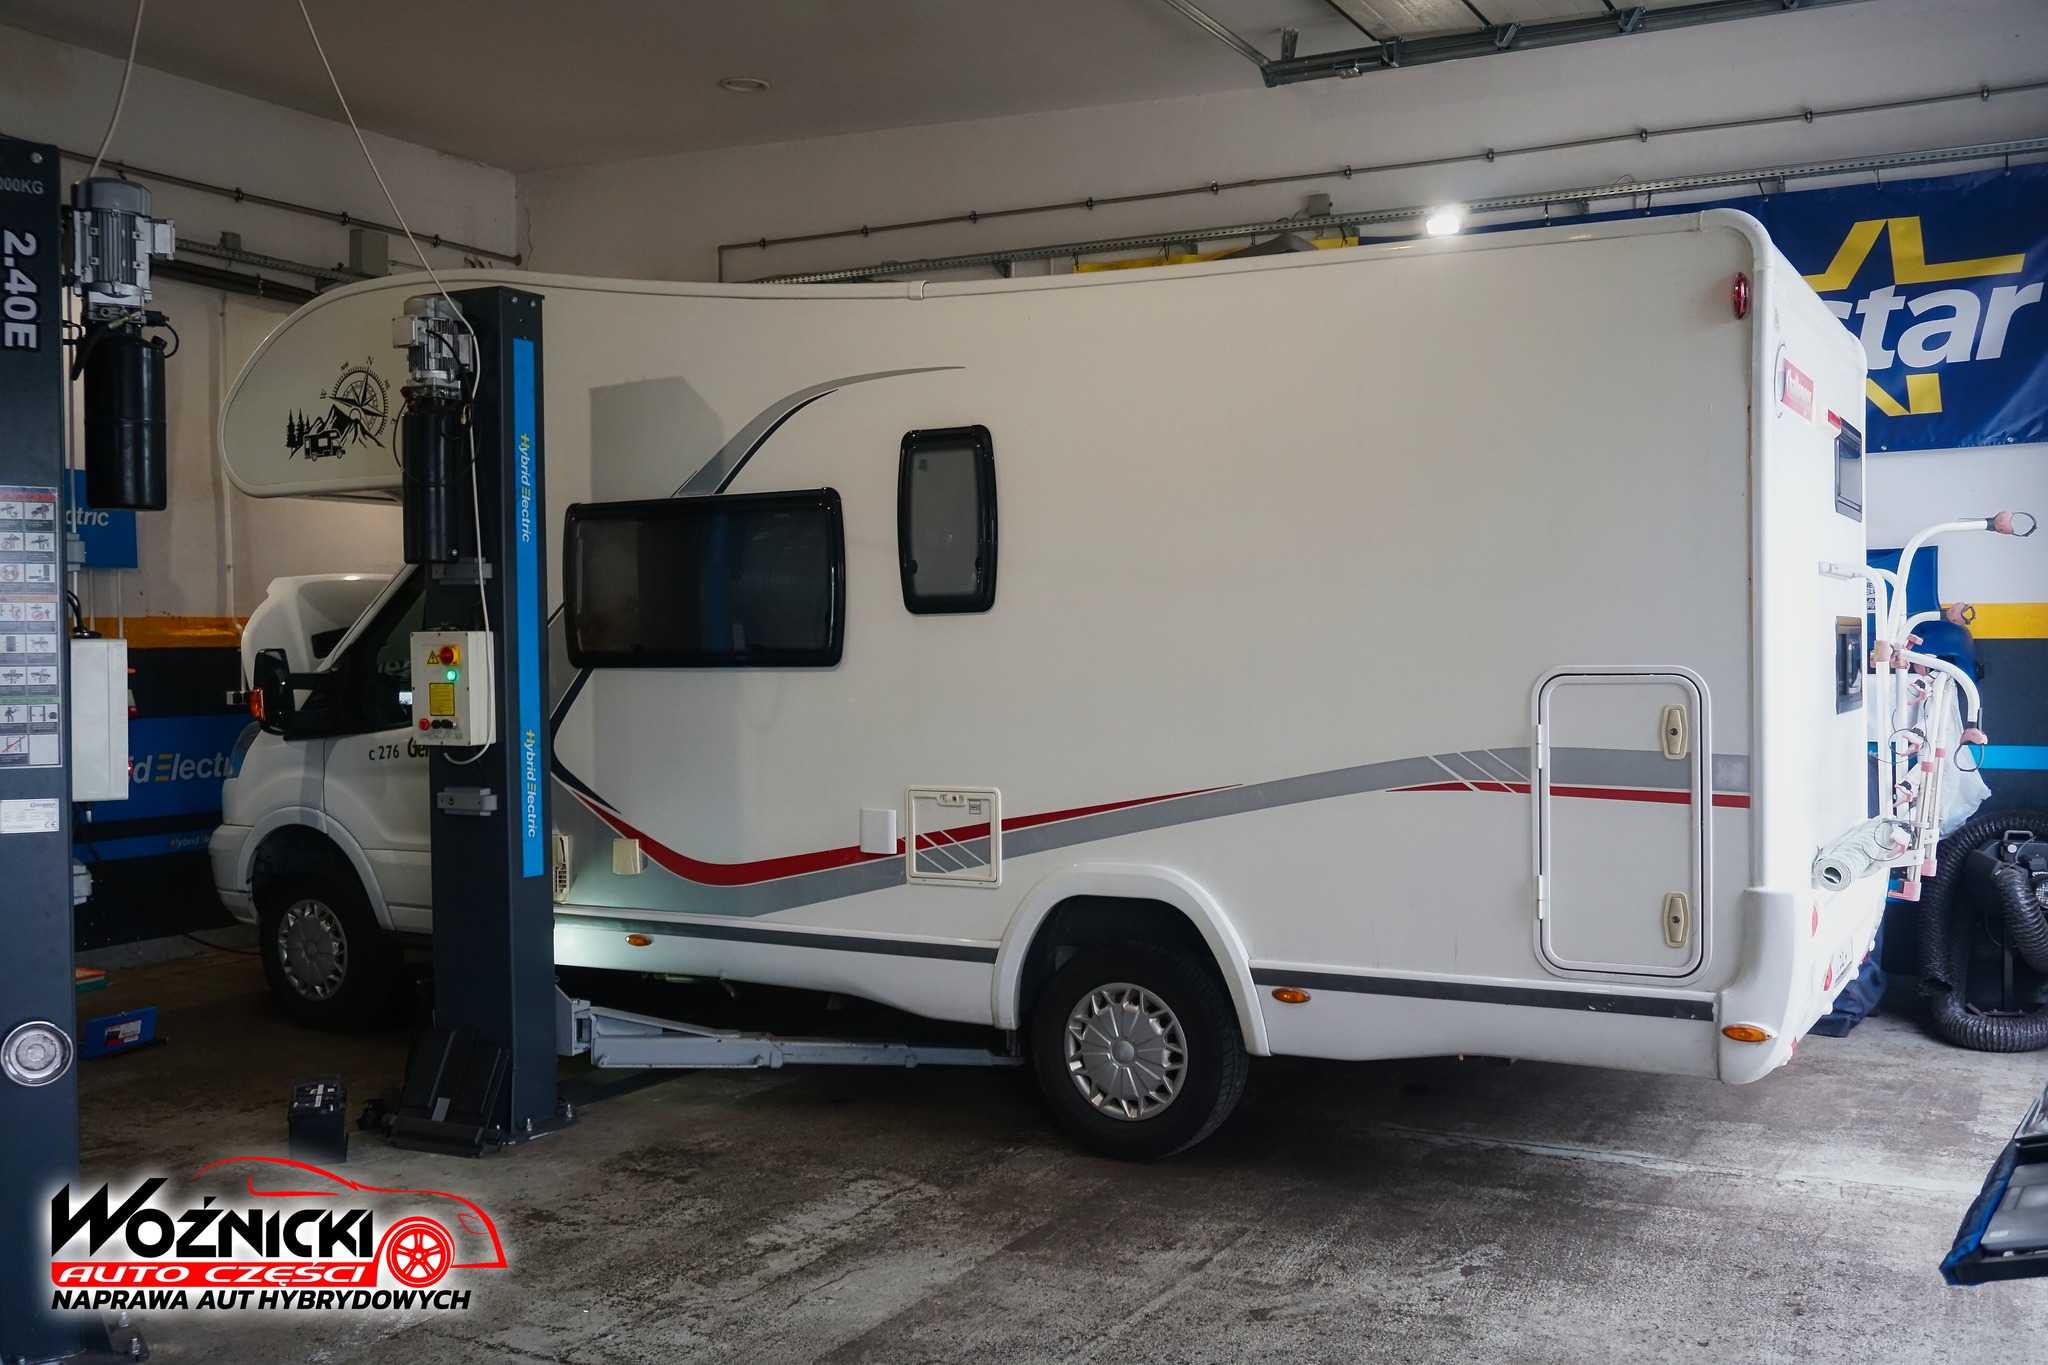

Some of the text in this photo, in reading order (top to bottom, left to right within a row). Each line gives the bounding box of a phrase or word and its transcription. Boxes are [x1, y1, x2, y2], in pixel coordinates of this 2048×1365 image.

[4, 229, 37, 349] 2.40E
[519, 434, 531, 542] Hybrid Electric
[379, 745, 399, 759] 276
[524, 730, 537, 837] Hybrid Electric
